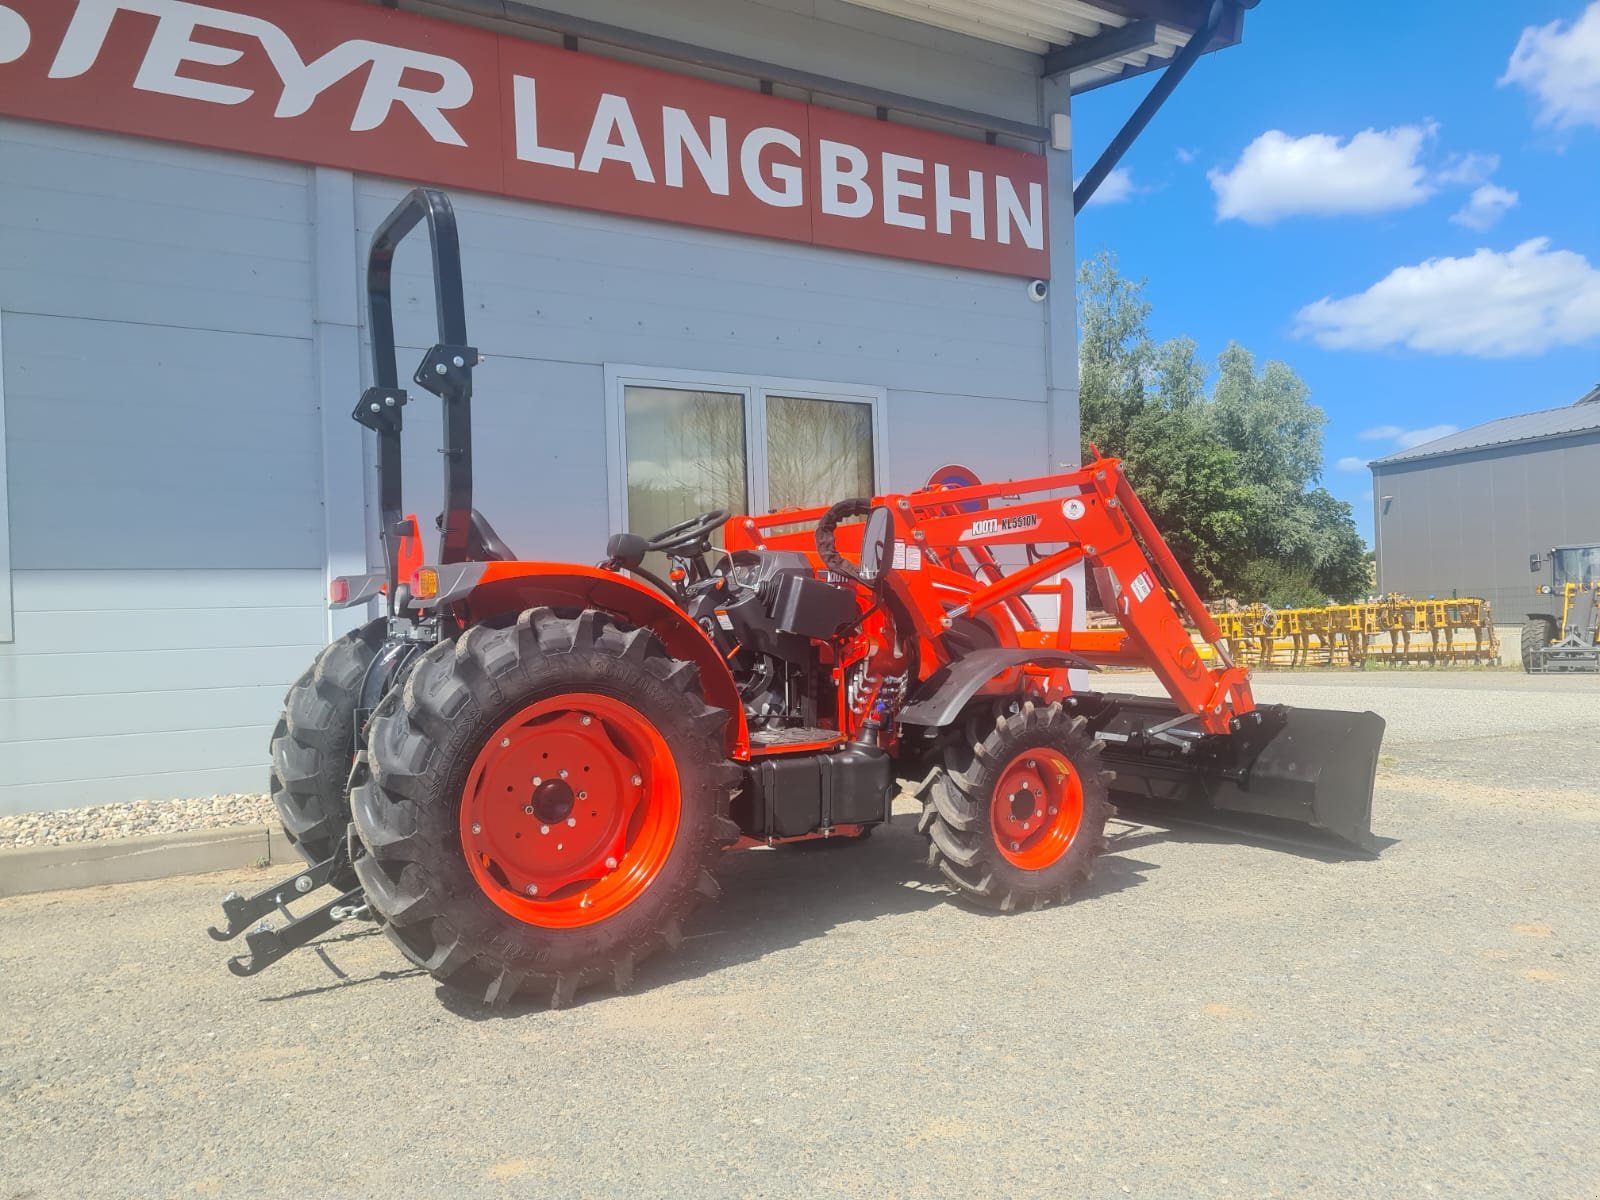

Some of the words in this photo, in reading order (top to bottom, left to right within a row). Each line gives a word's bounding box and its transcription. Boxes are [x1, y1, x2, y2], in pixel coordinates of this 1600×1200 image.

[513, 74, 1044, 251] LANGBEHN
[972, 518, 998, 536] KIOTI
[1001, 513, 1038, 531] KL5510N
